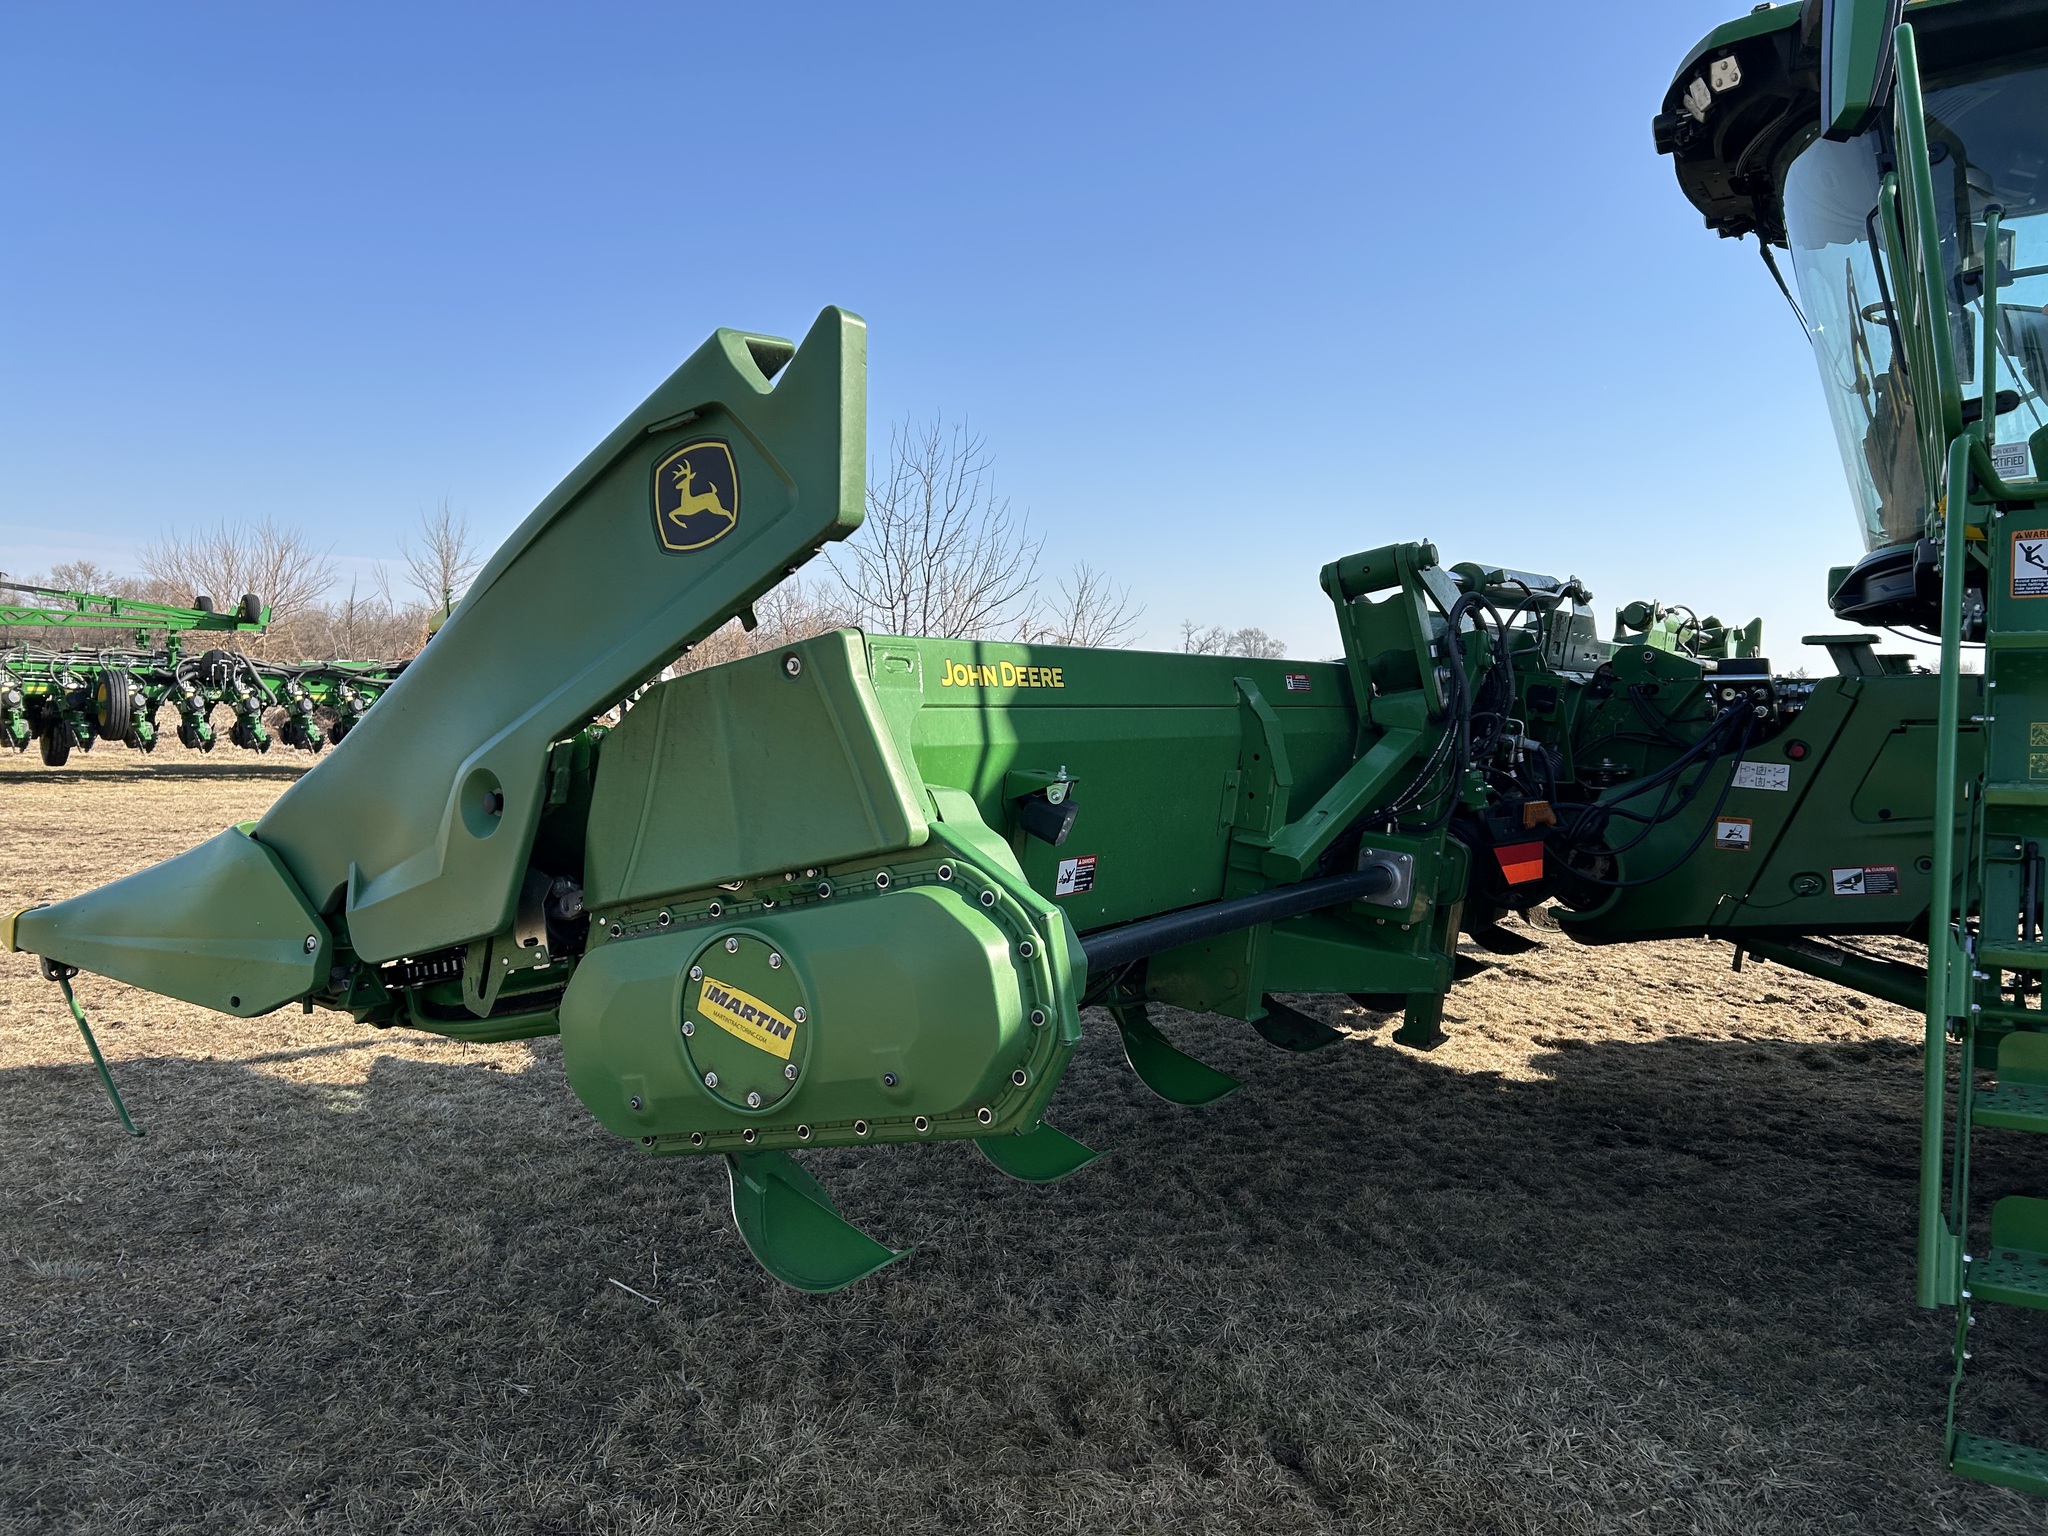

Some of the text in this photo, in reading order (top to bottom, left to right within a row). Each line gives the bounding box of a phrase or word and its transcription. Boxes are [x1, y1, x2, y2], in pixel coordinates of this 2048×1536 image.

[1994, 456, 2023, 467] RTIFIED
[941, 658, 1065, 688] JOHN DEERE
[704, 985, 793, 1041] MARTIN
[712, 1010, 768, 1044] MARTINTRACTORINC.COM
